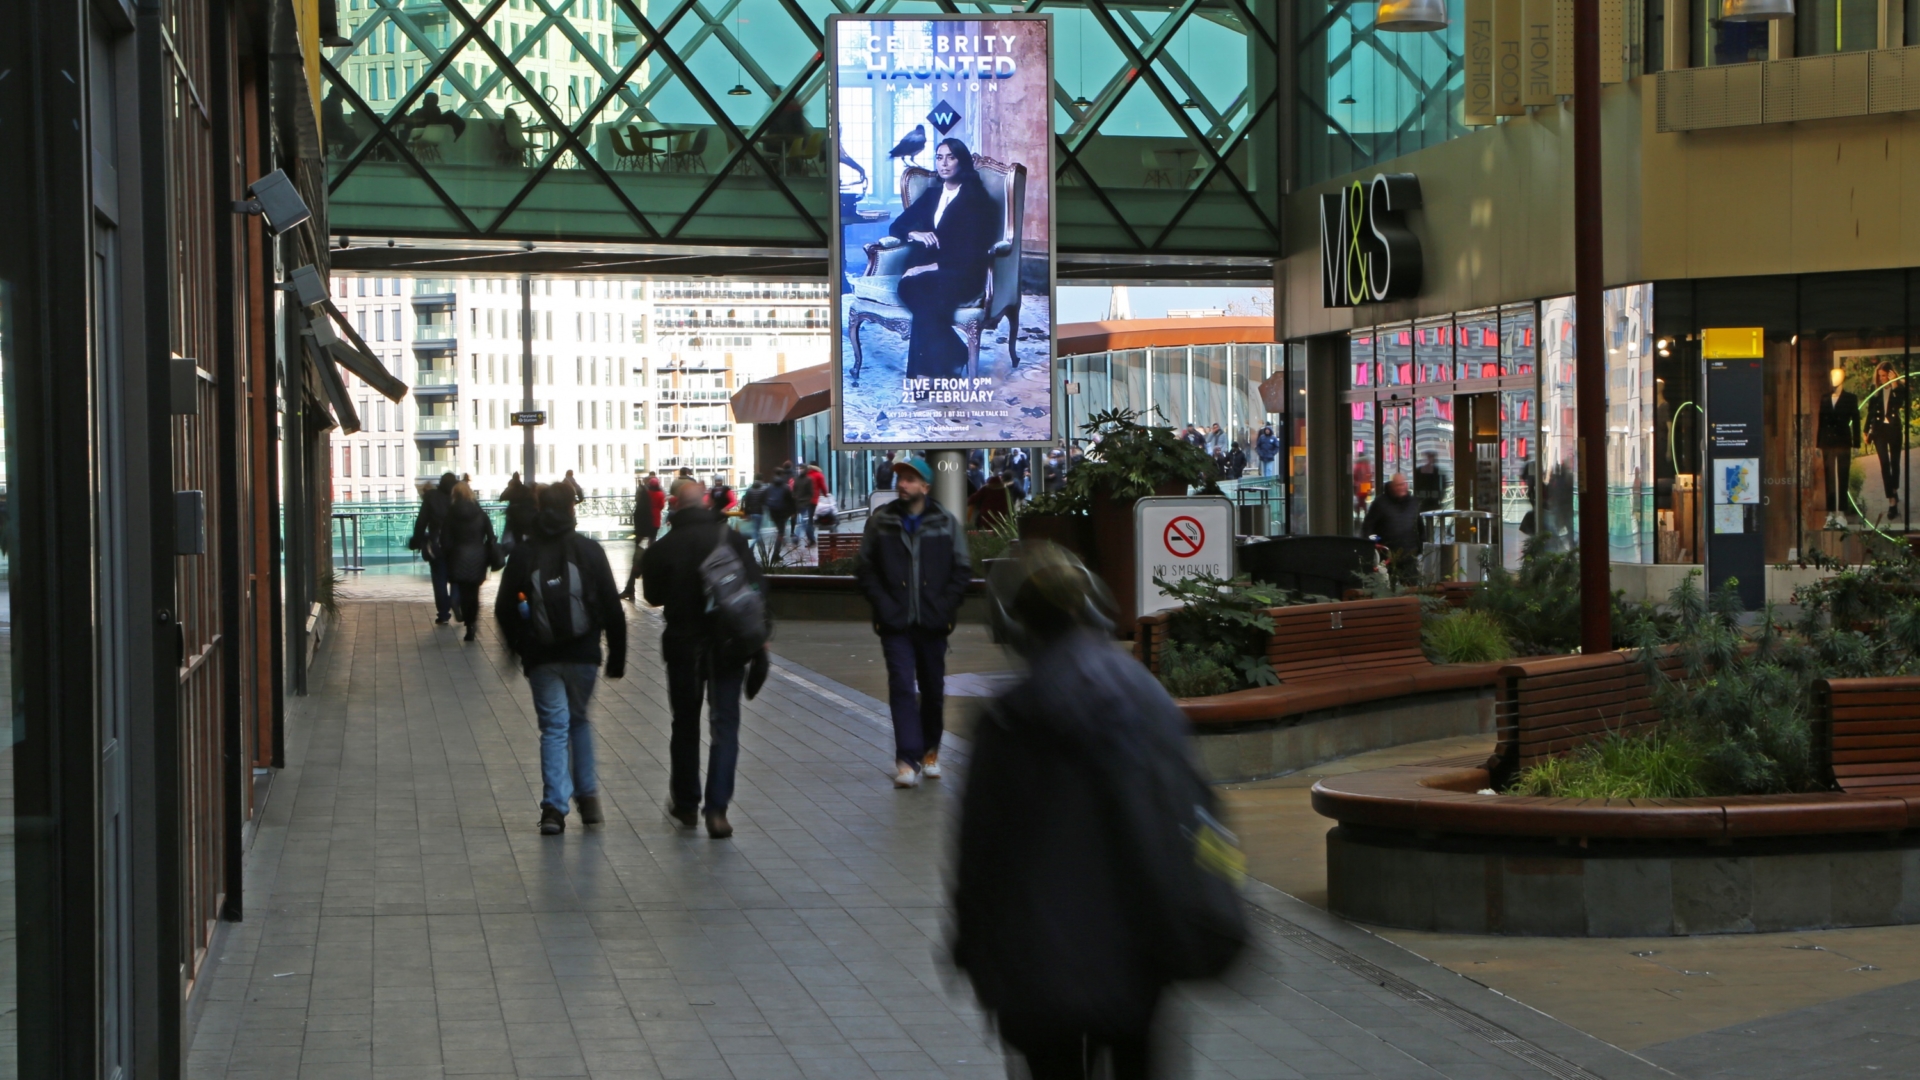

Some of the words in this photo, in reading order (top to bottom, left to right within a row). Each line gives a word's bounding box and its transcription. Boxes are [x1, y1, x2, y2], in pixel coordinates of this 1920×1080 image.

[866, 36, 1016, 53] CELEBRITY
[866, 56, 1016, 80] HAUNTED
[1472, 20, 1490, 116] FASHION
[1531, 24, 1549, 95] HOME
[1501, 42, 1519, 105] FOOD
[886, 82, 998, 92] MANSION
[934, 112, 953, 125] W
[1320, 173, 1391, 308] M&S
[902, 378, 930, 390] LIVE
[934, 378, 968, 390] FROM
[972, 377, 992, 390] 9PM
[902, 391, 925, 403] 21ST
[928, 390, 994, 403] FEBRUARY
[1153, 565, 1166, 576] NO
[1172, 564, 1219, 576] SMOKING
